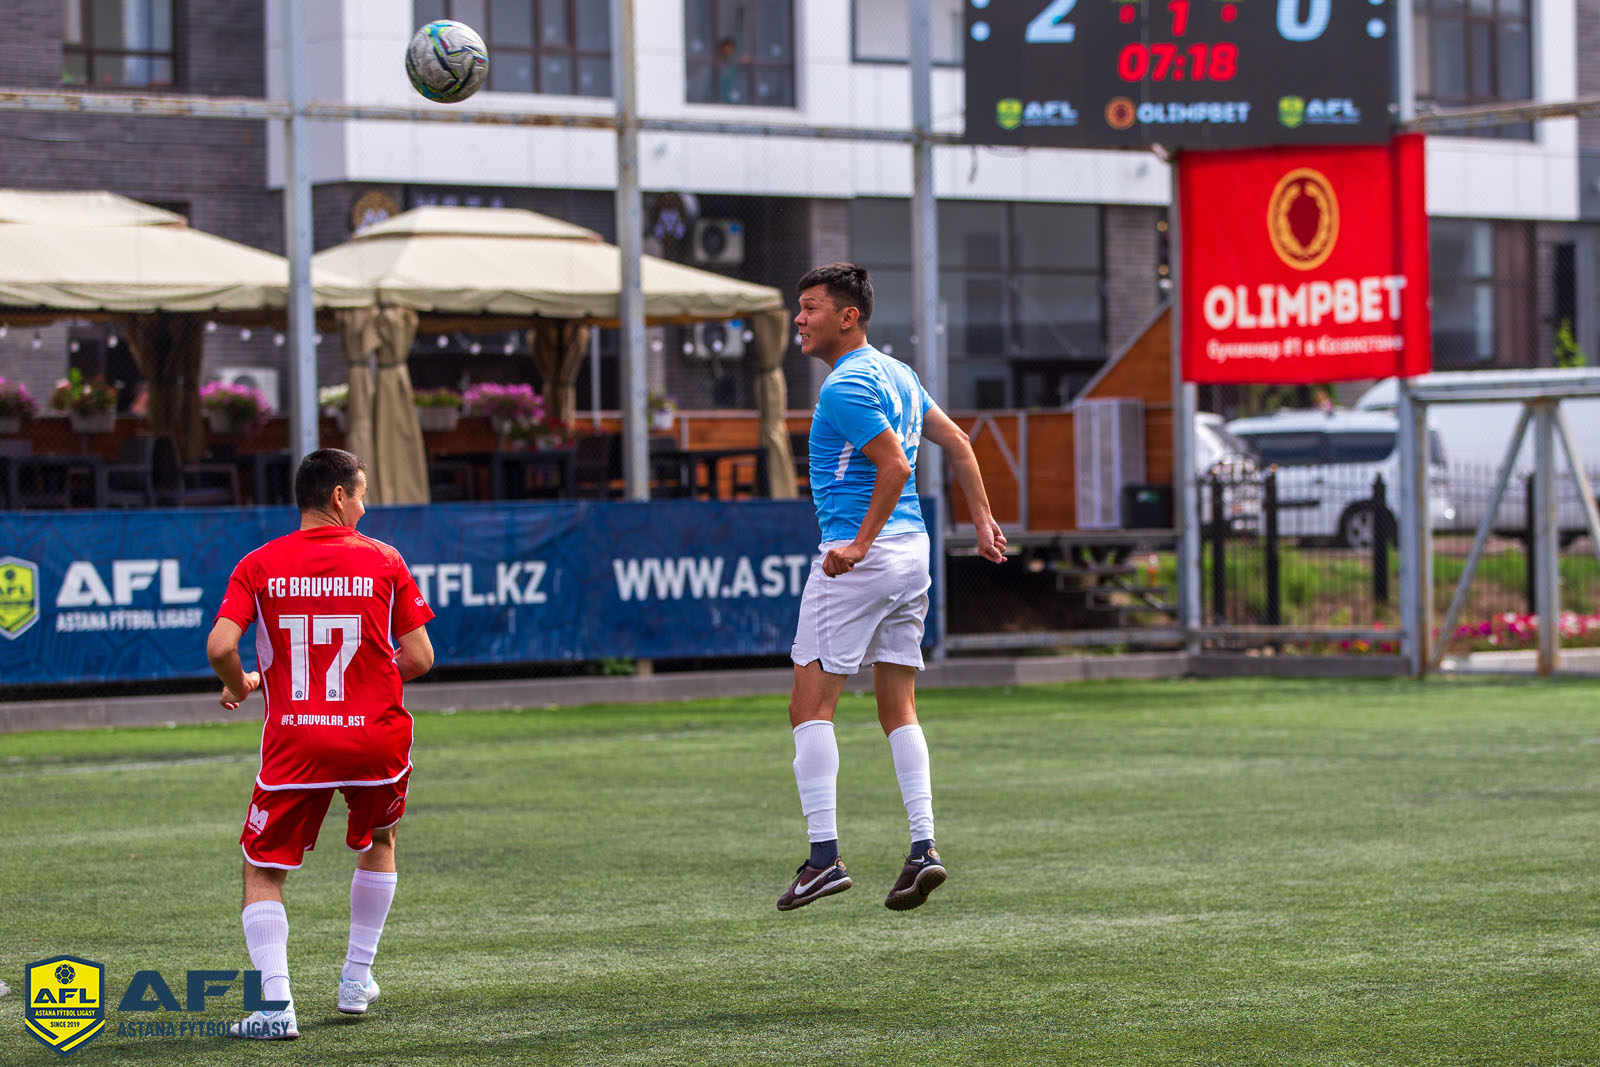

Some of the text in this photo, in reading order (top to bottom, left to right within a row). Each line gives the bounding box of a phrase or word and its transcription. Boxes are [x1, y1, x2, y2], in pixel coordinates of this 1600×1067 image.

[1167, 0, 1189, 36] 1
[1117, 42, 1239, 82] 07:18
[1023, 100, 1079, 120] AFL
[1136, 102, 1250, 124] OLIMPBET
[1305, 98, 1361, 118] AFL
[1203, 275, 1407, 331] OLIMPBET
[56, 559, 204, 607] AFL
[268, 576, 374, 598] FC BAUYRLAR
[410, 561, 548, 607] TFL.KZ
[613, 554, 819, 601] WWW.AST
[56, 611, 108, 632] ASTANA
[278, 614, 362, 702] 17
